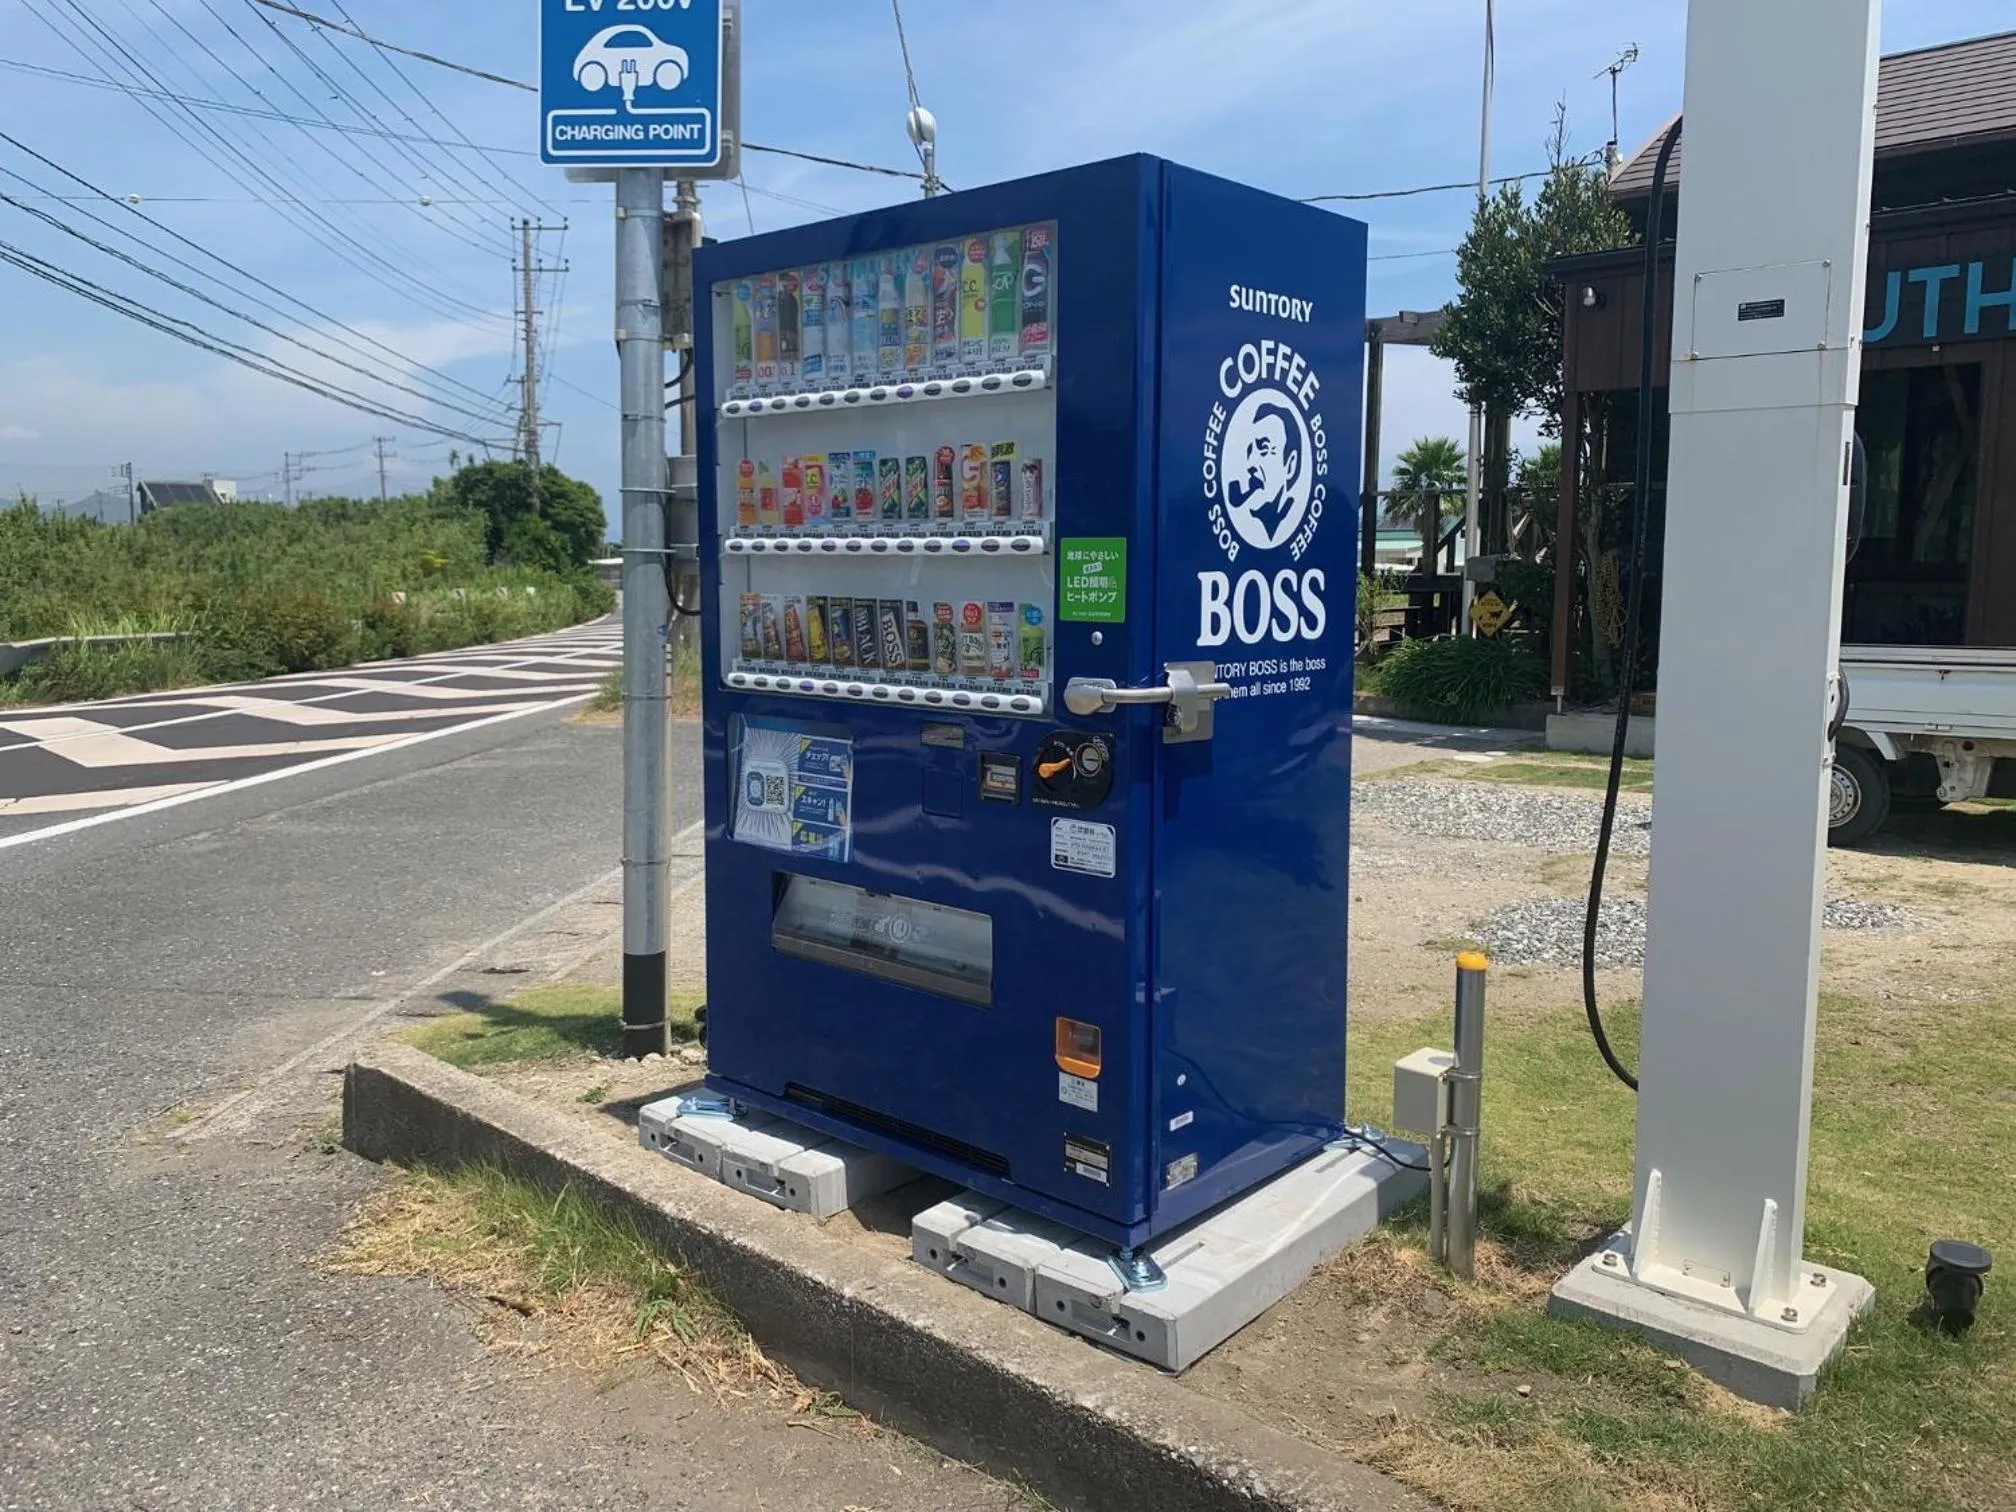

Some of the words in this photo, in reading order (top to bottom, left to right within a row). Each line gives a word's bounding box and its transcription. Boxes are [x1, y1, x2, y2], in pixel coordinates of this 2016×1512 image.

[555, 125, 644, 141] CHARGING
[649, 124, 702, 140] POINT
[1219, 339, 1320, 411] COFFEE
[1202, 401, 1227, 498] COFFEE
[1310, 413, 1328, 476] BOSS
[1208, 503, 1240, 562] BOSS
[1289, 483, 1326, 562] COFFEE
[1066, 590, 1118, 603] ヒートポンプ
[1196, 568, 1327, 647] BOSS
[1249, 659, 1278, 676] BOSS
[1280, 659, 1289, 673] is
[1290, 658, 1303, 672] the
[1305, 656, 1326, 671] boss
[1249, 681, 1261, 697] all
[1262, 680, 1287, 696] since
[1289, 677, 1311, 692] 1992
